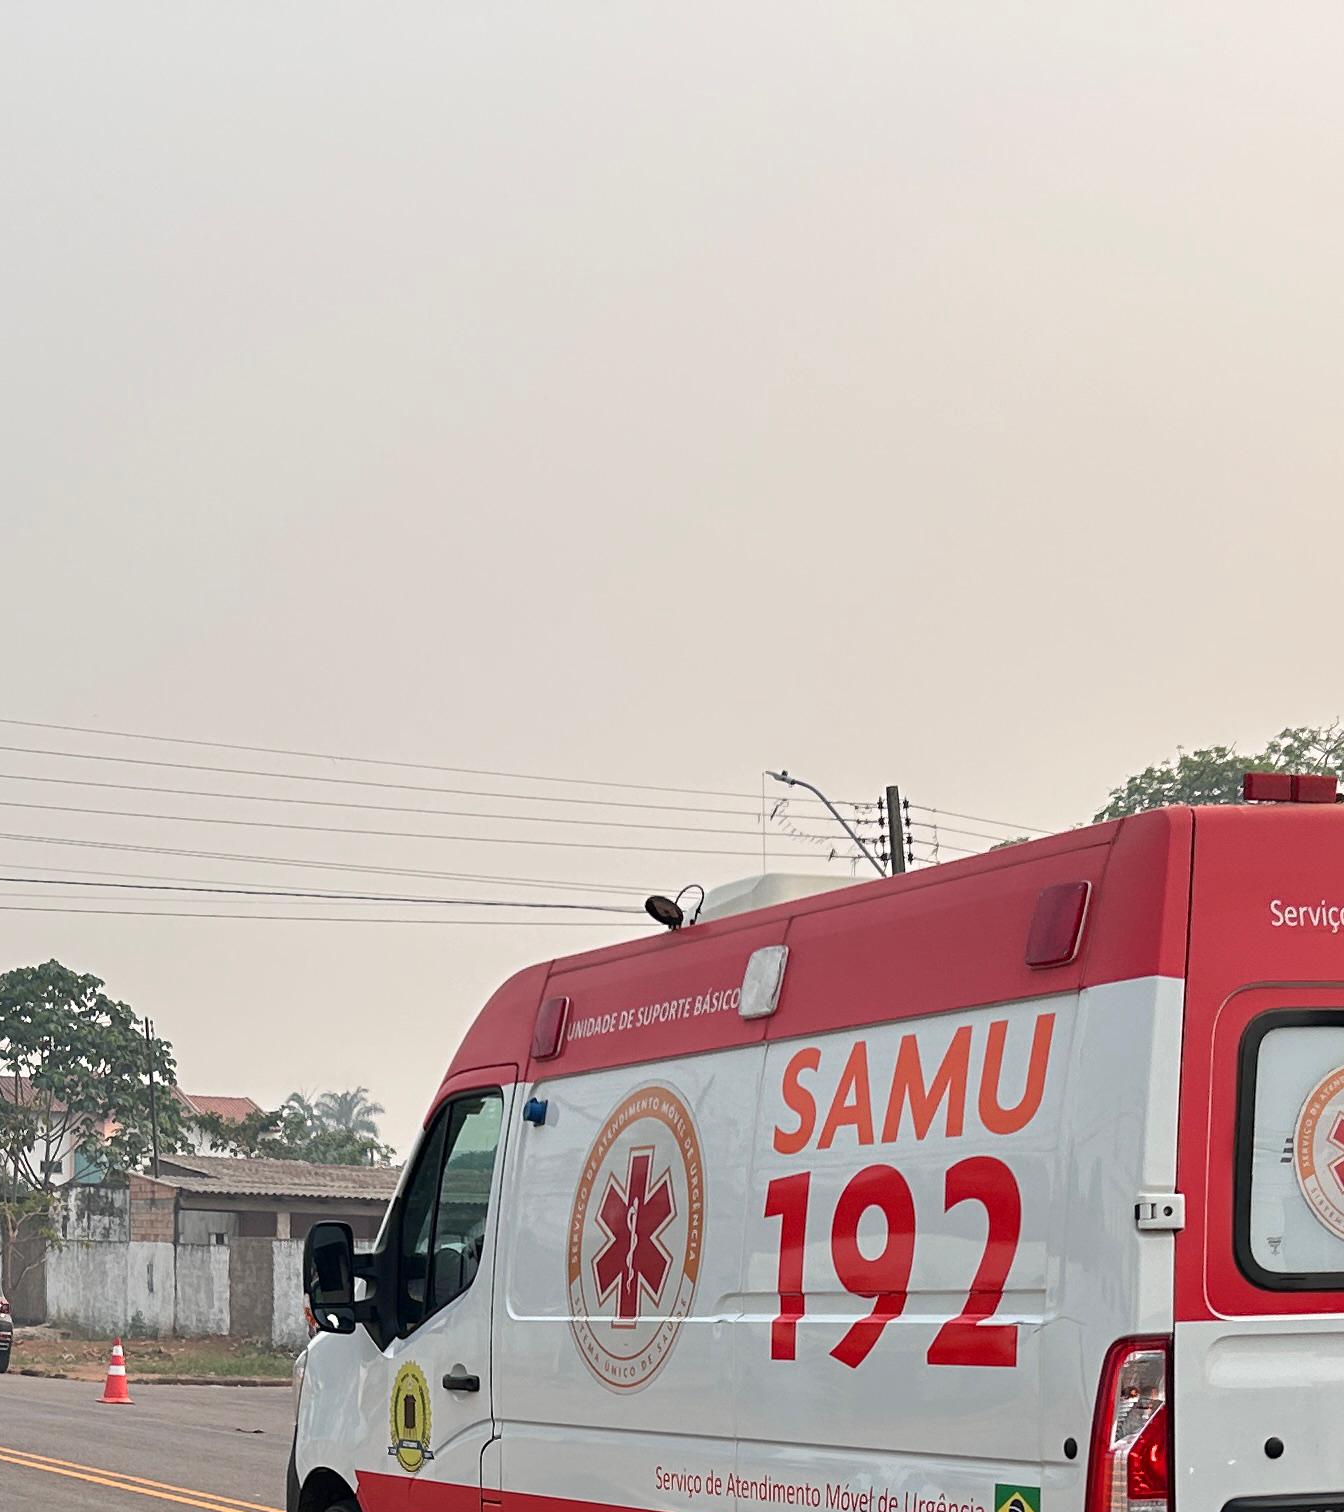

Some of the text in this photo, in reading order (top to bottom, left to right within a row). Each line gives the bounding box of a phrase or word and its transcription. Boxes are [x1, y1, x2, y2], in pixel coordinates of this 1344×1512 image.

[567, 987, 741, 1041] UNIDADE DE SUPORTE BÁSICO
[773, 1012, 1056, 1155] SAMU
[598, 1097, 660, 1157] ATENDIMENTO
[764, 1156, 1022, 1369] 192
[574, 1297, 599, 1363] SITEMA
[656, 1465, 702, 1498] Serviço
[706, 1469, 722, 1496] de
[726, 1473, 820, 1508] Atendimento
